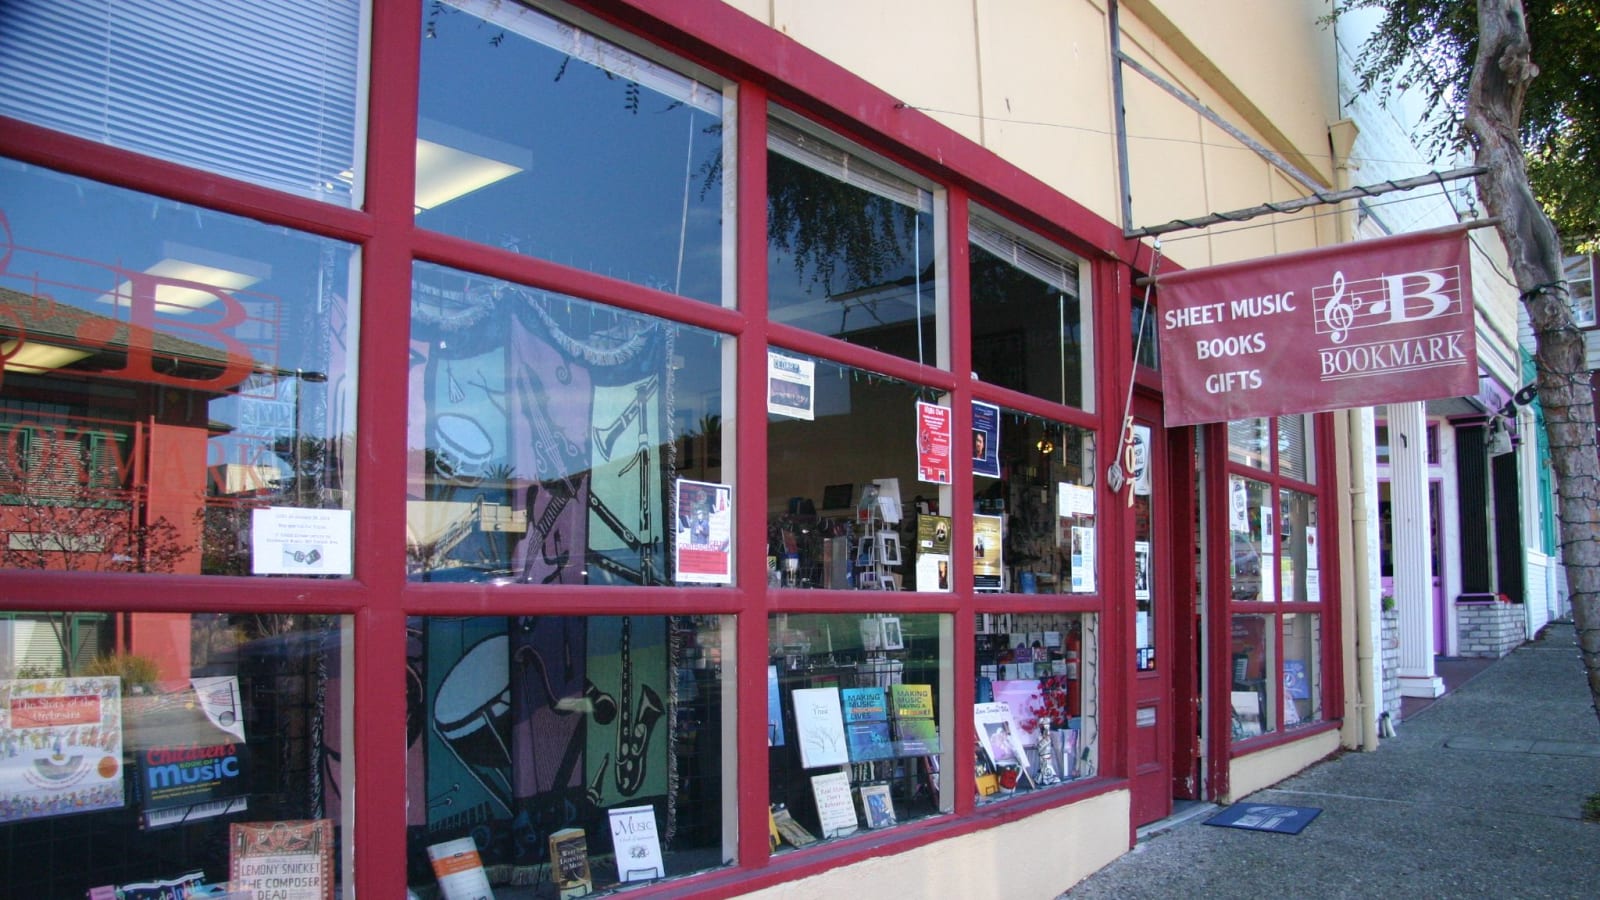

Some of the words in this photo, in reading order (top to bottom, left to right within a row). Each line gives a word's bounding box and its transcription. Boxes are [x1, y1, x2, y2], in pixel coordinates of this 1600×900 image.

[1165, 302, 1225, 330] SHEET
[1230, 291, 1296, 319] MUSIC
[1380, 271, 1451, 325] B
[101, 270, 255, 391] B
[1196, 332, 1266, 360] BOOKS
[1319, 332, 1466, 376] BOOKMARK
[1205, 369, 1263, 394] GIFTS
[848, 693, 881, 702] MAKING
[241, 863, 281, 876] LEMONY
[282, 862, 320, 875] SNICKET
[241, 878, 262, 890] THE
[265, 877, 320, 889] COMPOSER
[257, 889, 288, 900] DEAD
